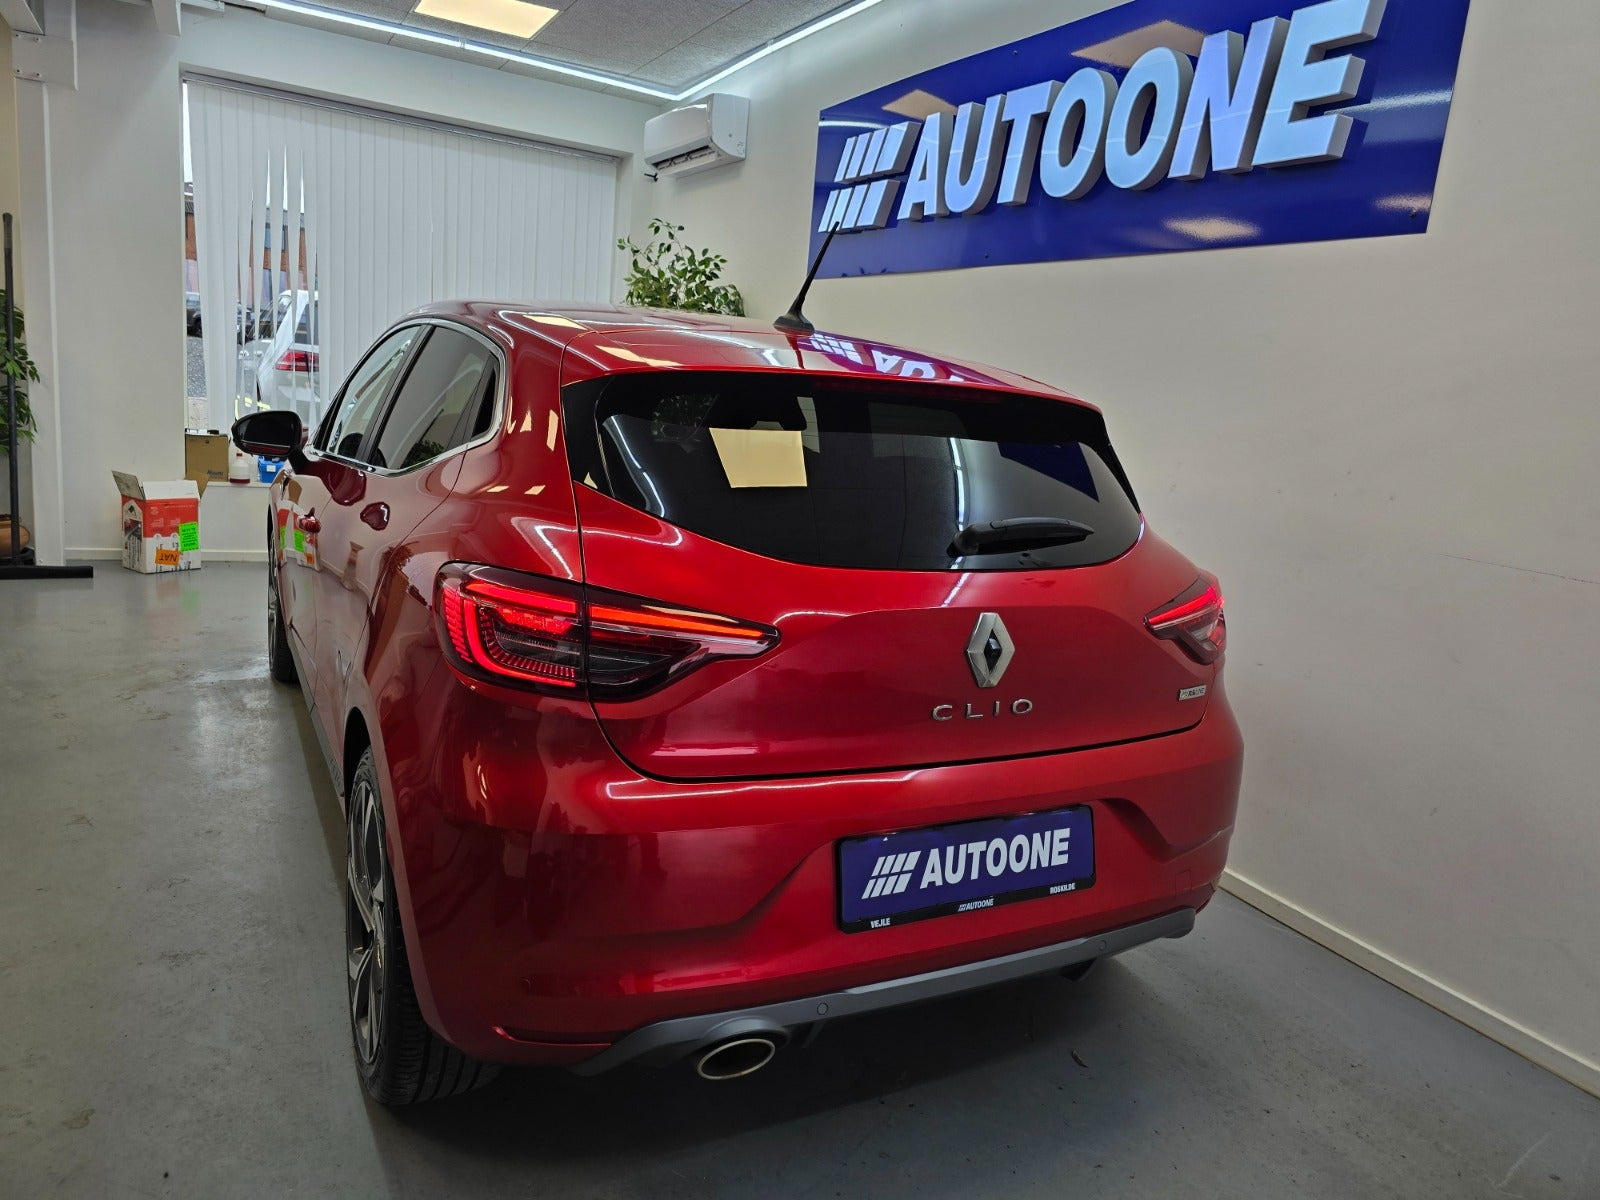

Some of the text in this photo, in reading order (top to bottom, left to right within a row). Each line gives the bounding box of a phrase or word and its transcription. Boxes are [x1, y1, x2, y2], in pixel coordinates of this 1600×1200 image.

[898, 0, 1387, 221] AUTOONE
[158, 552, 178, 562] NAT
[932, 698, 1033, 721] CLIO
[919, 827, 1071, 890] AUTOONE
[965, 898, 995, 911] AUTOONE
[870, 917, 891, 929] VEJLE
